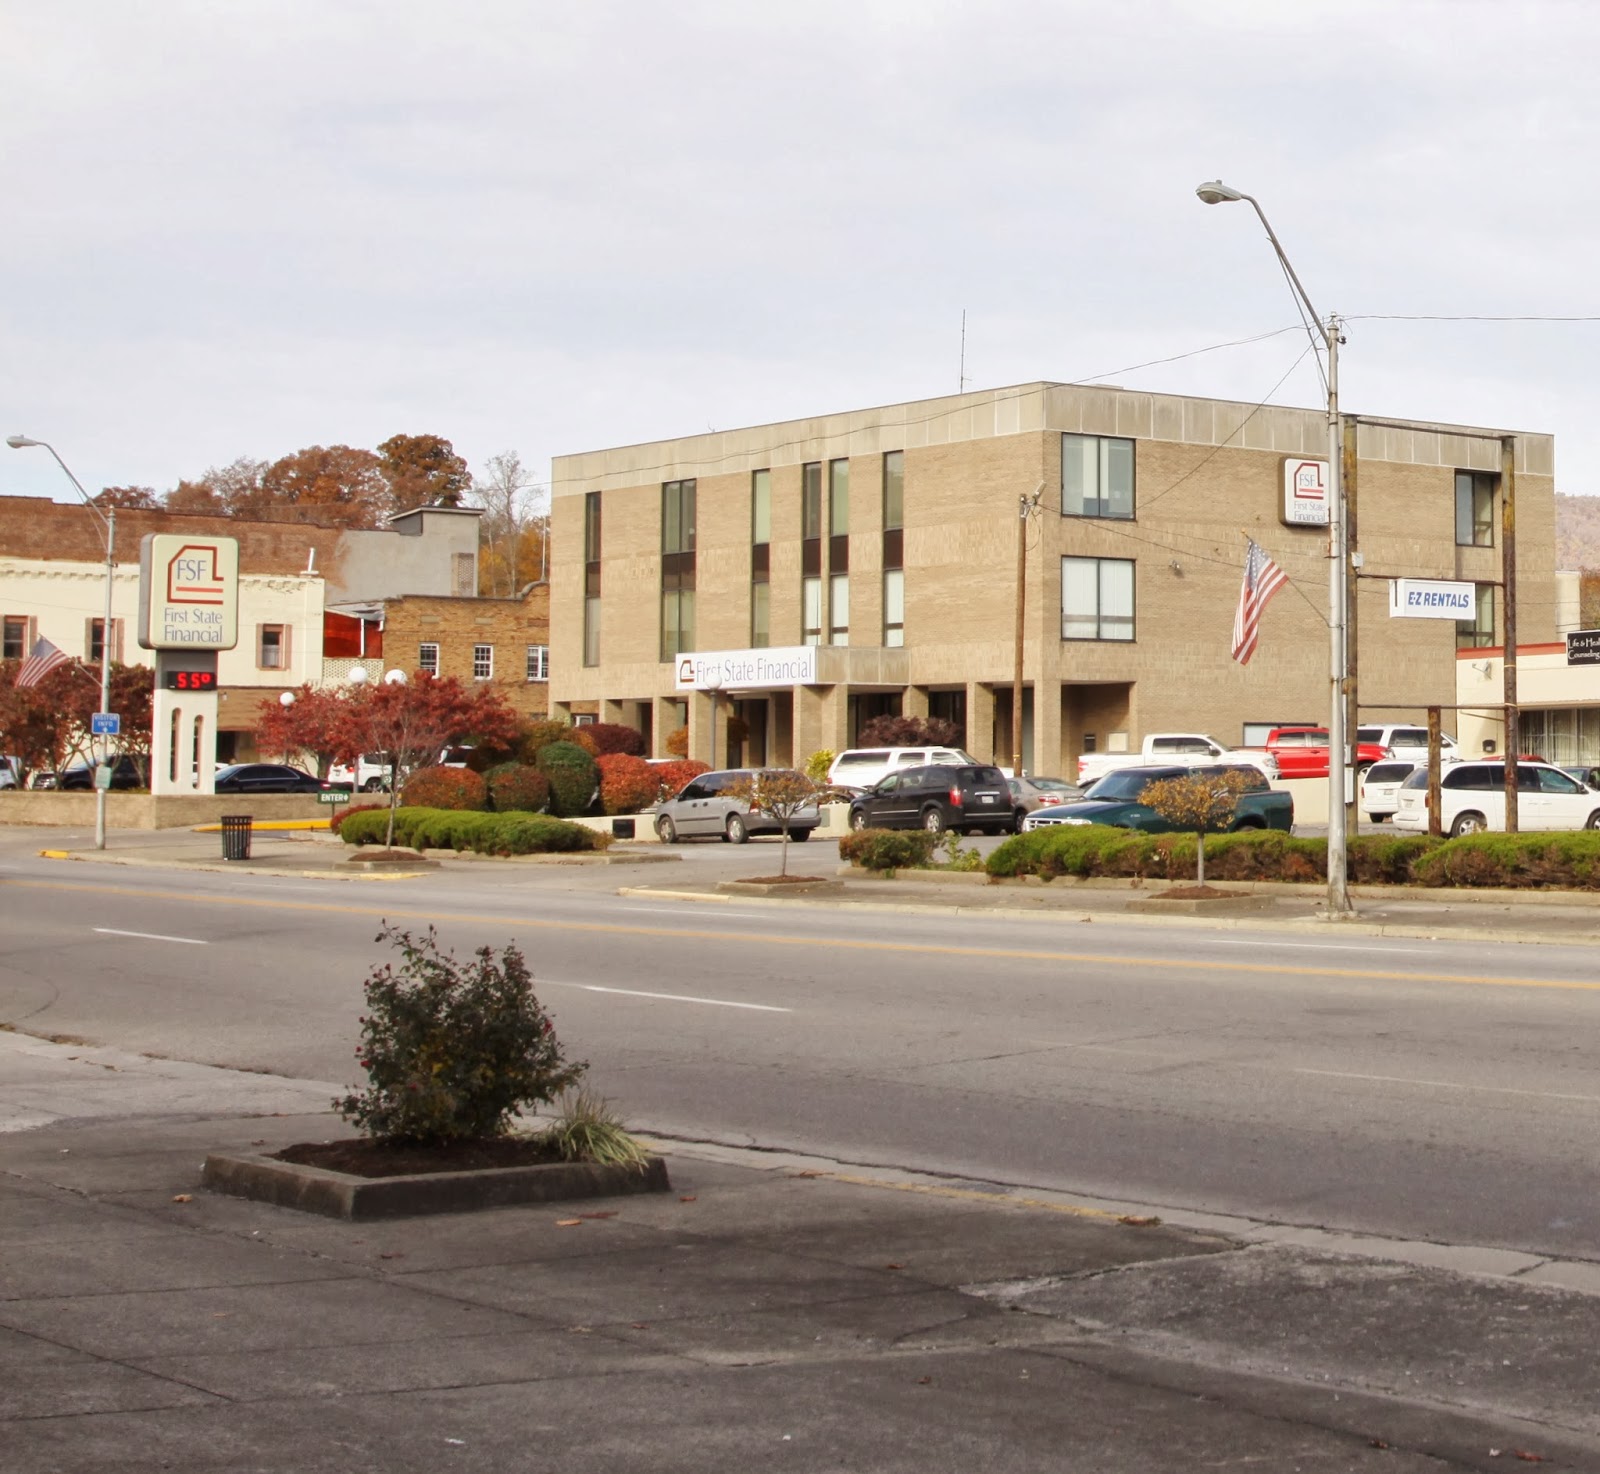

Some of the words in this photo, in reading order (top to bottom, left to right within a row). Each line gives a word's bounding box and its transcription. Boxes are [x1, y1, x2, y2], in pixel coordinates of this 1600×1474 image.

[1299, 473, 1315, 487] FSF
[1294, 500, 1307, 510] First
[176, 559, 207, 581] FSF
[1423, 592, 1469, 608] RENTALS
[164, 607, 188, 623] First
[193, 608, 223, 625] State
[164, 624, 223, 643] Financial
[724, 659, 754, 682] State
[757, 652, 812, 681] Financial
[321, 793, 344, 802] ENTER
